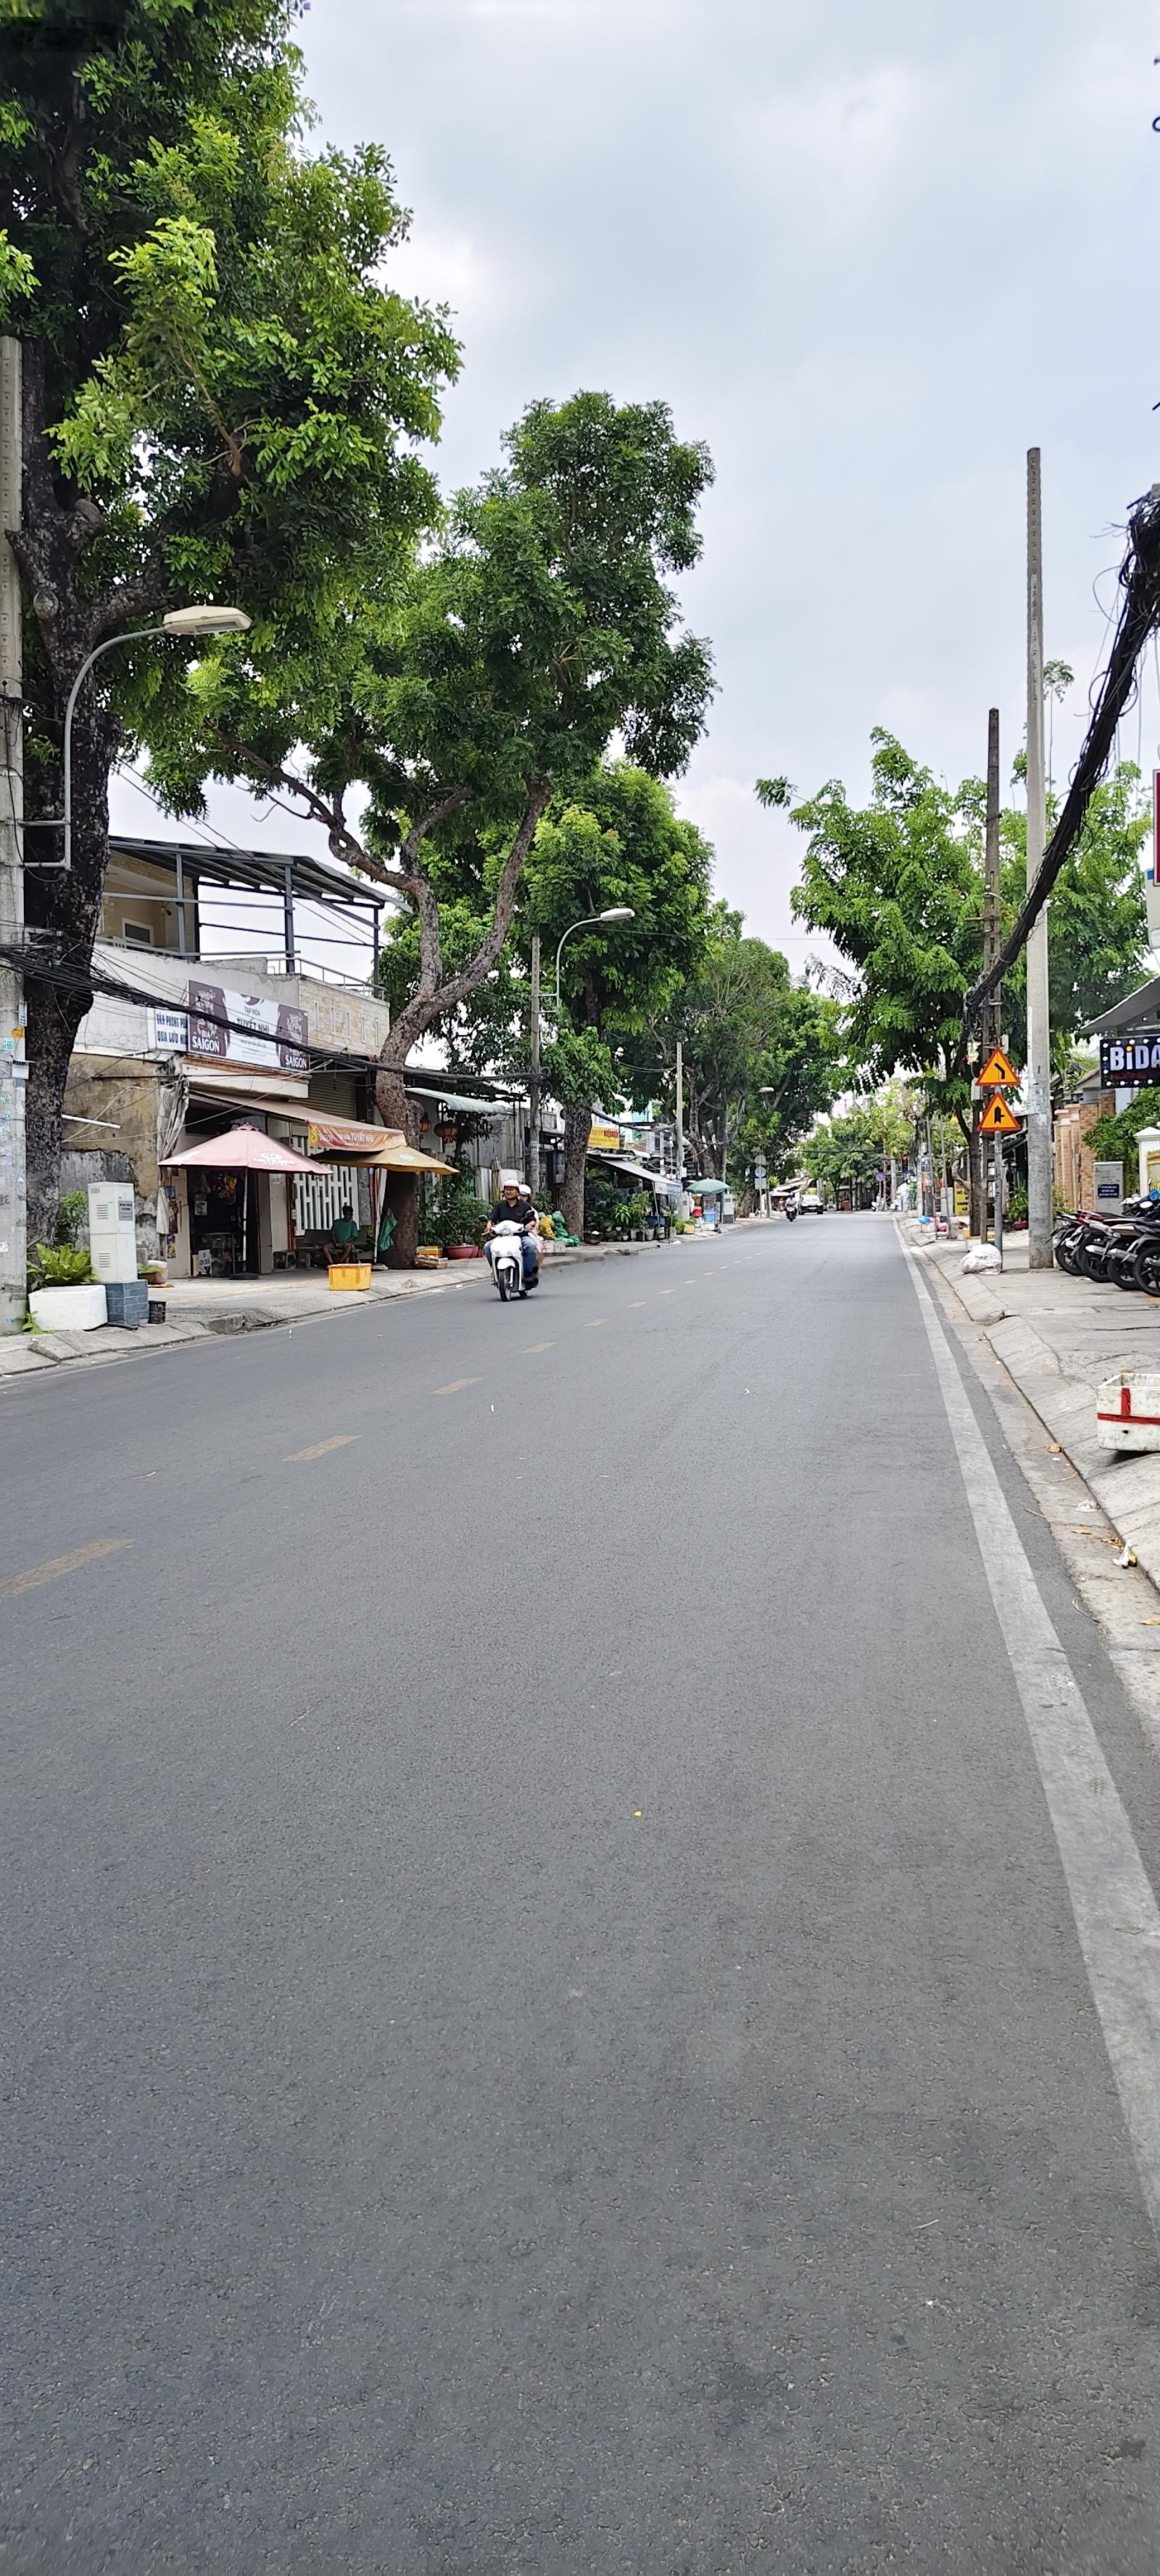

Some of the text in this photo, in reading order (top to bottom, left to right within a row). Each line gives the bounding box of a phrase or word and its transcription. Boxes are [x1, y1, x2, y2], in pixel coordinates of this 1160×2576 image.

[202, 1030, 210, 1039] BIA
[192, 1036, 220, 1052] SAIGON
[285, 1054, 307, 1069] SAIGON
